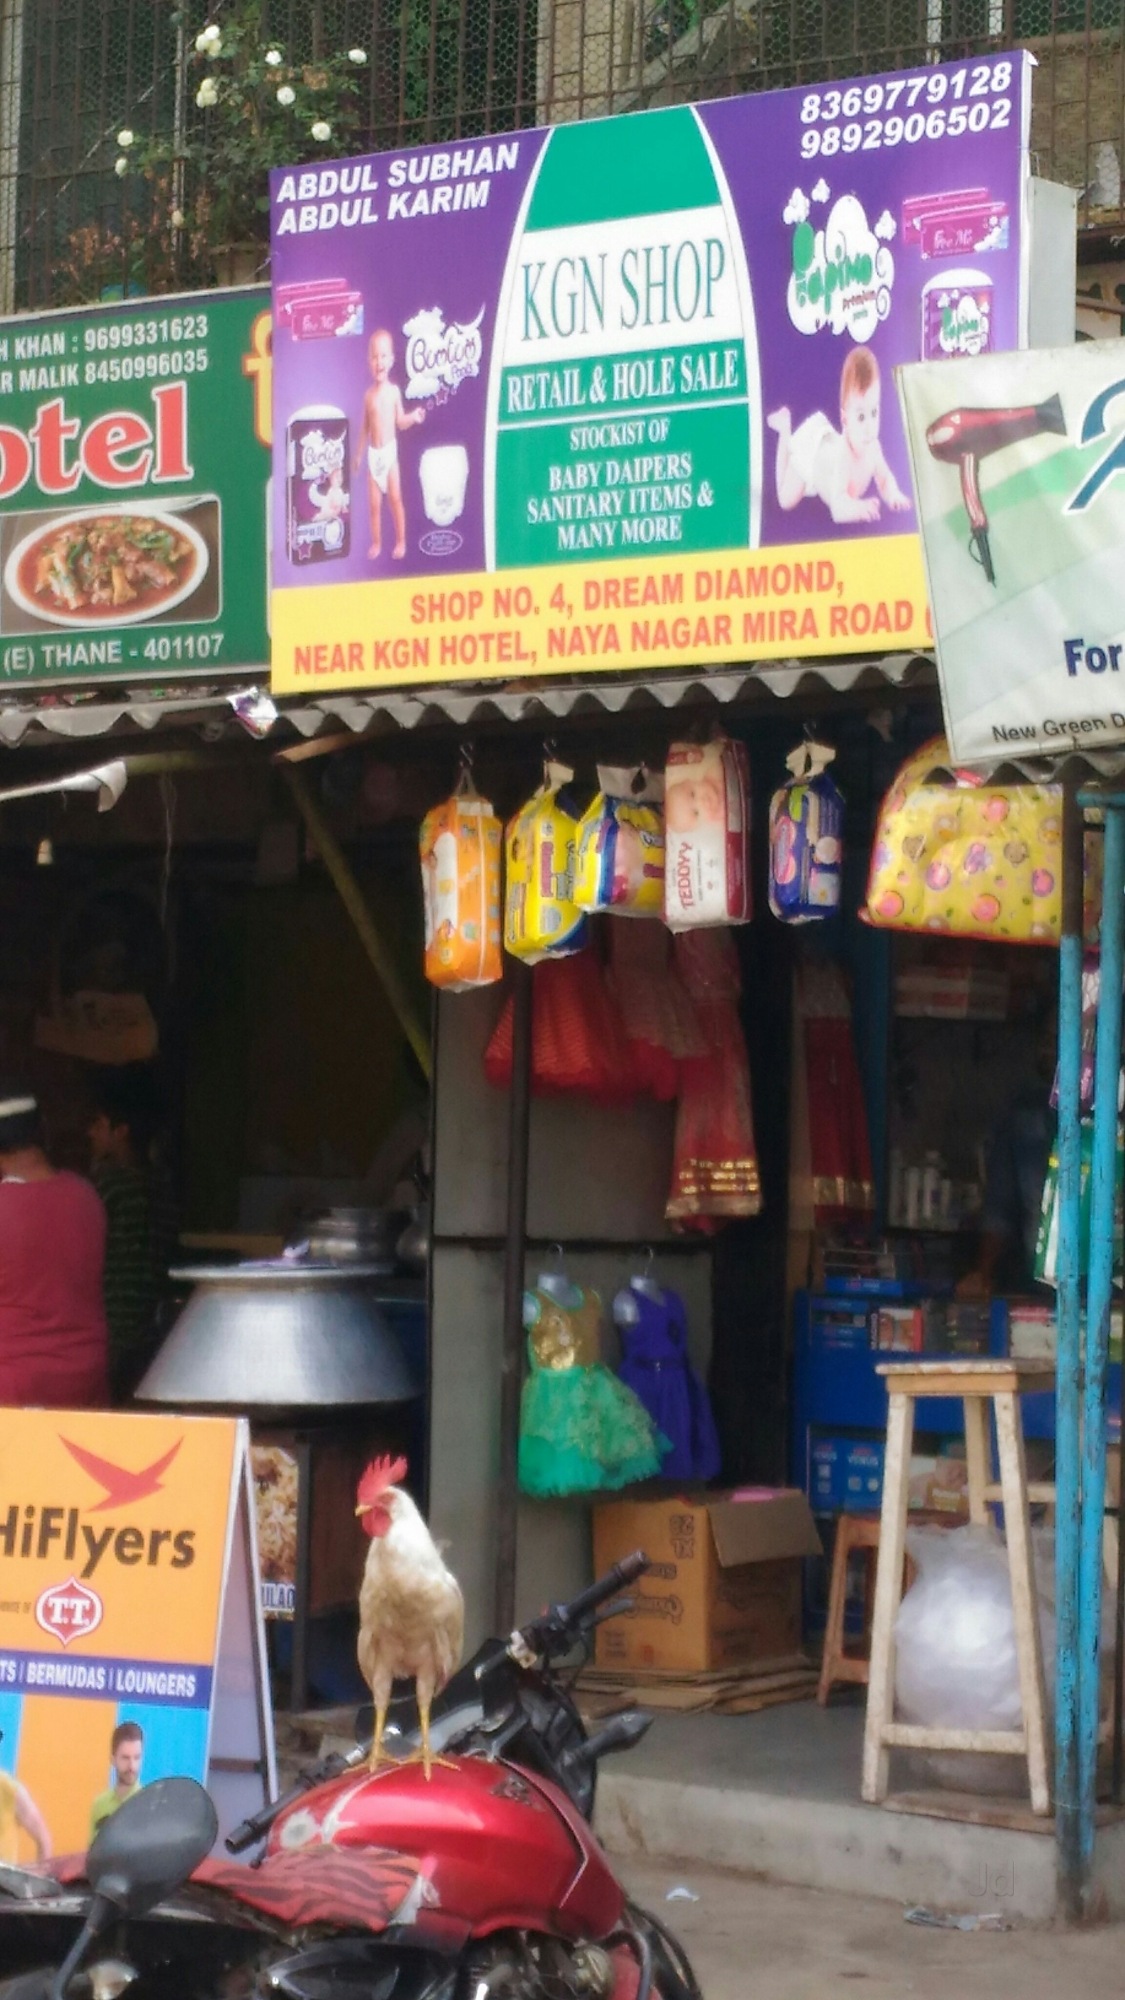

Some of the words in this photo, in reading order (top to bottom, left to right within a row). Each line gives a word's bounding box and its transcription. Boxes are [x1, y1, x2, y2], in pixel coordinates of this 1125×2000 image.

[801, 62, 1012, 124] 8369779128
[801, 99, 1012, 159] 9892906502
[276, 165, 378, 202] ABDUL
[388, 142, 520, 188] SUBHAN
[276, 198, 378, 235] ABDUL
[388, 180, 490, 220] KARIM
[521, 253, 608, 341] KGN
[621, 238, 725, 330] SHOP
[15, 331, 66, 360] KHAN
[84, 315, 208, 352] 9699331623
[19, 363, 79, 392] MALIK
[85, 348, 208, 384] 8450996035
[507, 367, 586, 413] RETAIL
[589, 364, 606, 403] &
[612, 354, 675, 401] HOLE
[681, 349, 738, 394] SALE
[569, 421, 645, 451] STOCKIST
[648, 417, 670, 442] OF
[549, 462, 602, 492] BABY
[606, 452, 692, 486] DAIPERS
[527, 491, 626, 524] SANITARY
[629, 483, 692, 514] ITEMS
[697, 480, 714, 507] &
[557, 520, 618, 551] MANY
[621, 514, 682, 544] MORE
[410, 590, 483, 625] SHOP
[493, 586, 540, 619] NO.
[549, 583, 574, 619] 4,
[584, 573, 684, 612] DREAM
[695, 560, 844, 601] DIAMOND,
[4, 646, 35, 676] (E)
[41, 640, 122, 669] THANE
[143, 634, 225, 663] 401107
[294, 642, 365, 676] NEAR
[374, 637, 429, 670] KGN
[440, 631, 538, 668] HOTEL,
[548, 623, 620, 658] NAYA
[631, 616, 732, 652] NAGAR
[742, 608, 819, 644] MIRA
[830, 600, 914, 638] ROAD
[1063, 638, 1122, 677] For
[991, 724, 1037, 742] New
[1043, 718, 1107, 737] Green
[27, 1661, 105, 1690] BERMUDAS
[117, 1668, 196, 1698] LOUNGERS
